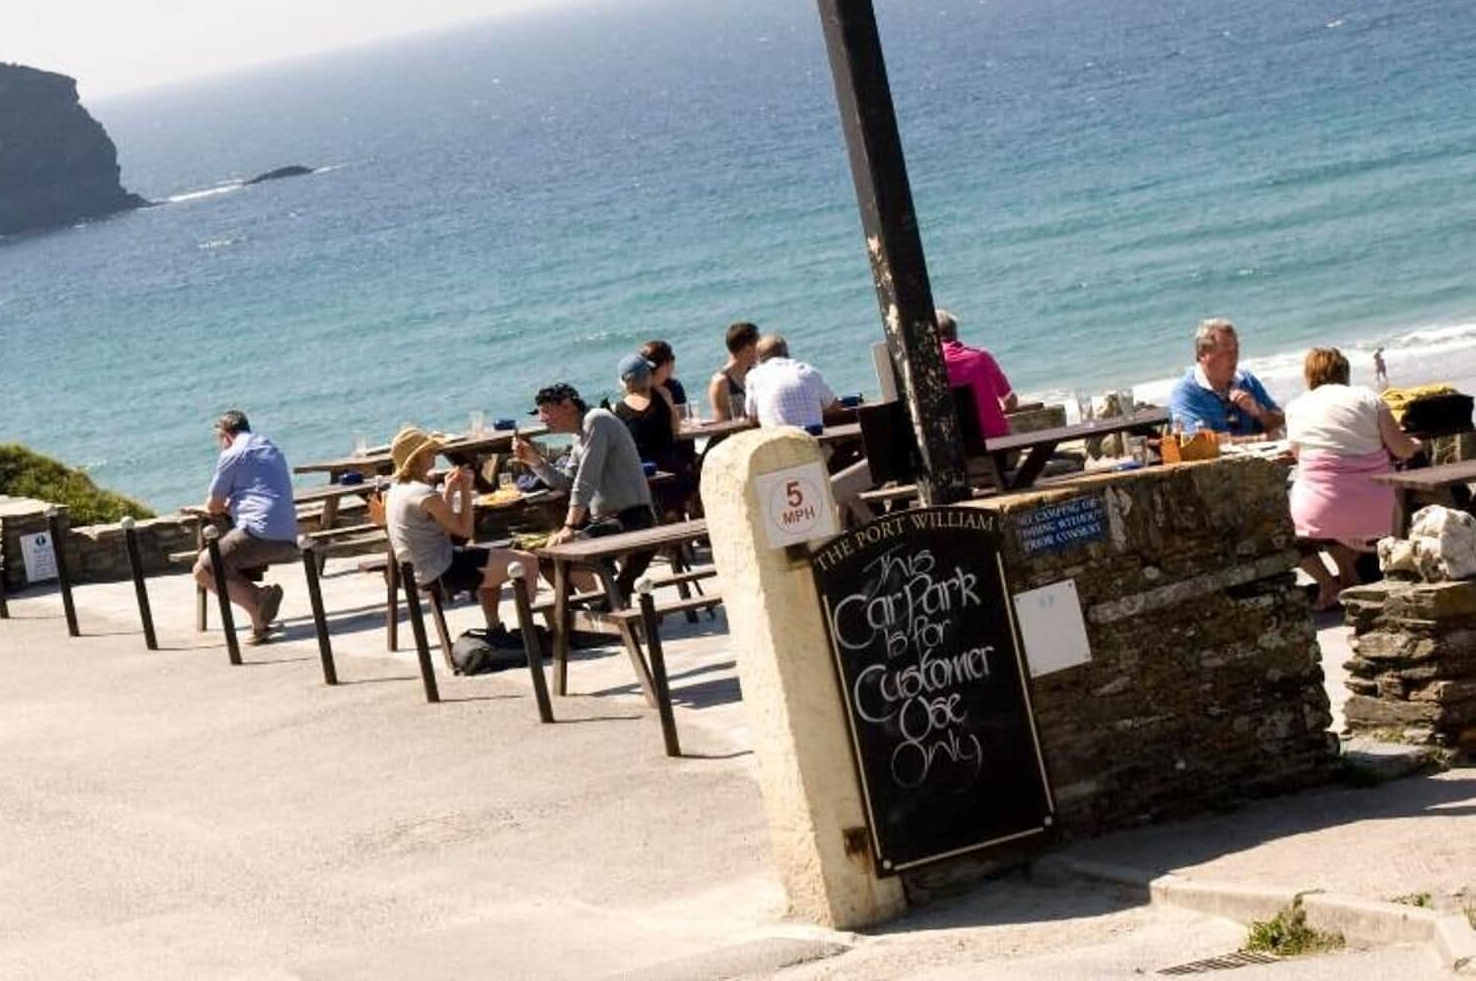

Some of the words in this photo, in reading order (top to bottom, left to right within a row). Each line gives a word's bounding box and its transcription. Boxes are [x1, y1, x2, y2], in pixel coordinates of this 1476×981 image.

[782, 506, 816, 524] MPH
[786, 480, 804, 508] 5
[816, 537, 855, 571] THE
[855, 517, 906, 548] PORT
[910, 510, 994, 532] WILLIAM
[862, 545, 936, 602] This
[912, 614, 953, 662] for
[853, 645, 996, 723] Customer
[890, 727, 983, 789] Only
